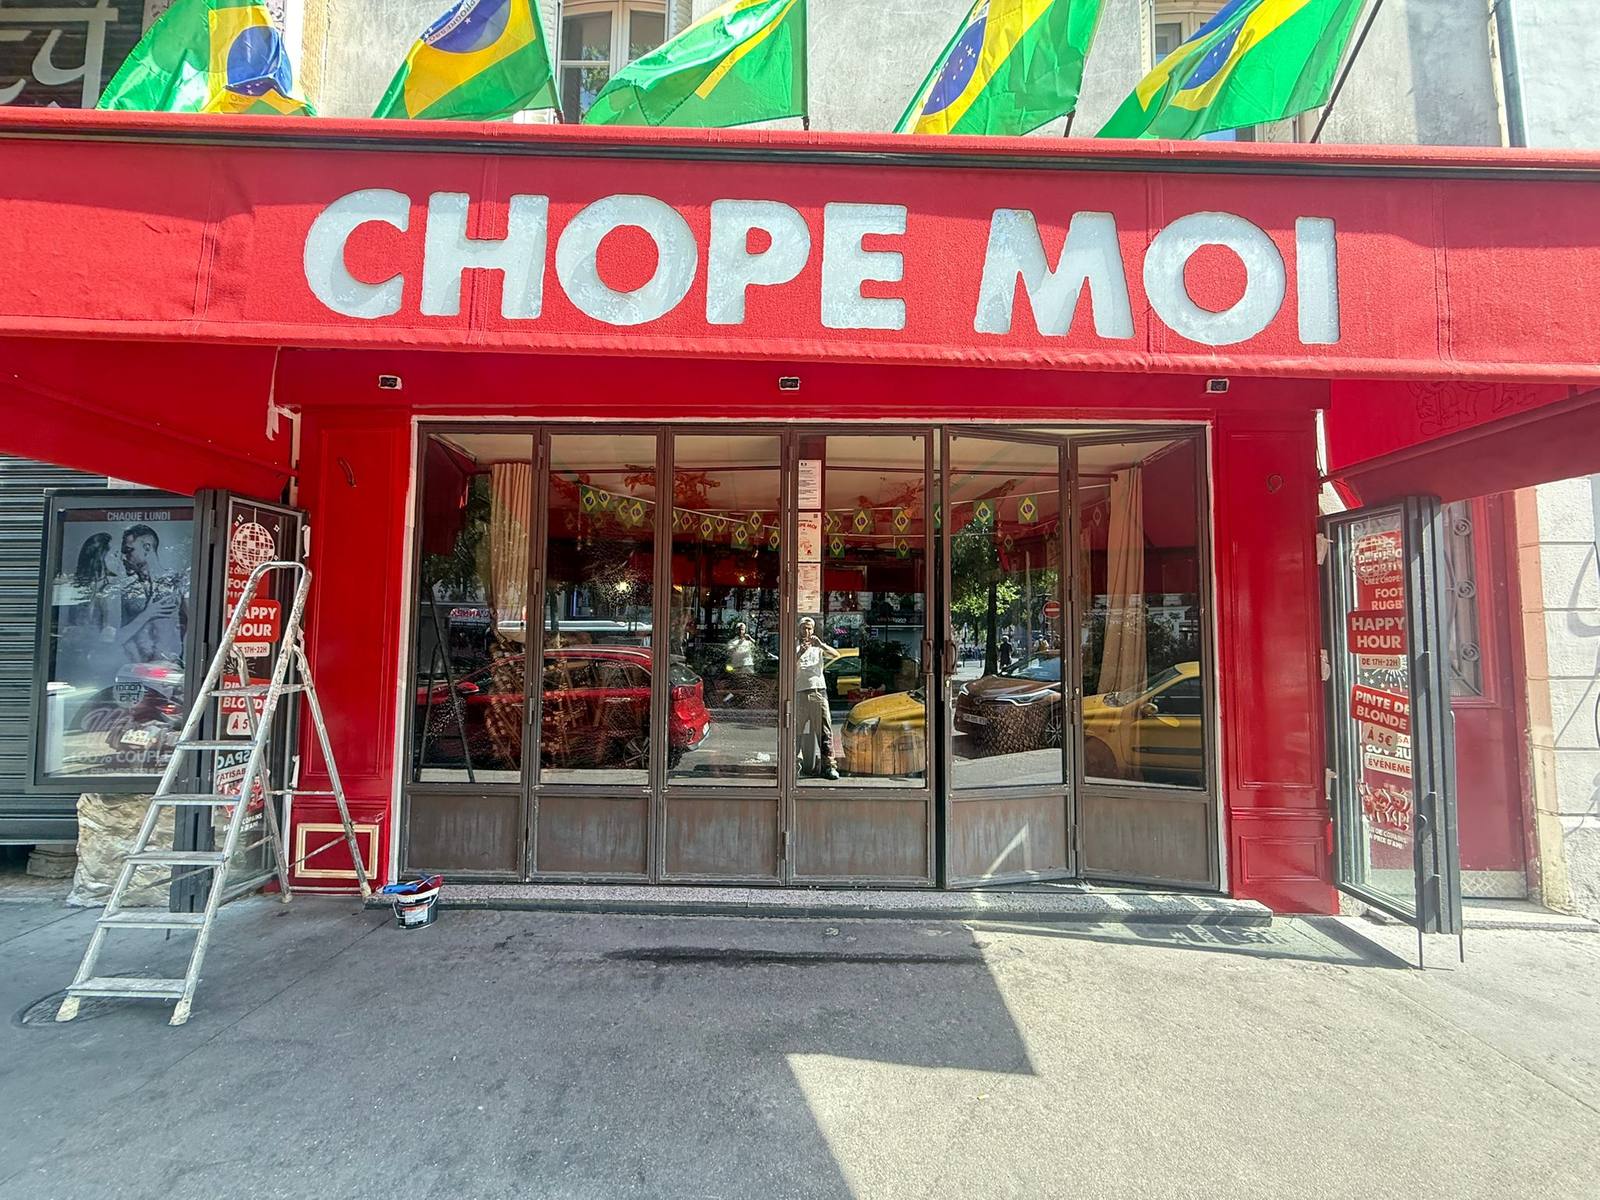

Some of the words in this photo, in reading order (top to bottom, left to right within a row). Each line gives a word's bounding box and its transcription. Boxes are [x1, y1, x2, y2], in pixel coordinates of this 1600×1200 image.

[304, 188, 908, 329] CHOPE
[974, 208, 1340, 346] MOI
[107, 511, 143, 521] CHAQUE
[144, 511, 171, 521] LUNDI
[1375, 587, 1403, 599] FOOT
[1352, 616, 1405, 631] HAPPY
[1356, 635, 1401, 649] HOUR
[1361, 657, 1370, 666] DE
[1372, 658, 1398, 667] 17H-22H
[1355, 690, 1391, 711] PINTE
[1393, 700, 1410, 717] DE
[242, 718, 250, 730] 5
[1356, 704, 1408, 731] BLONDE
[1367, 726, 1375, 741] À
[1378, 733, 1393, 747] 5€
